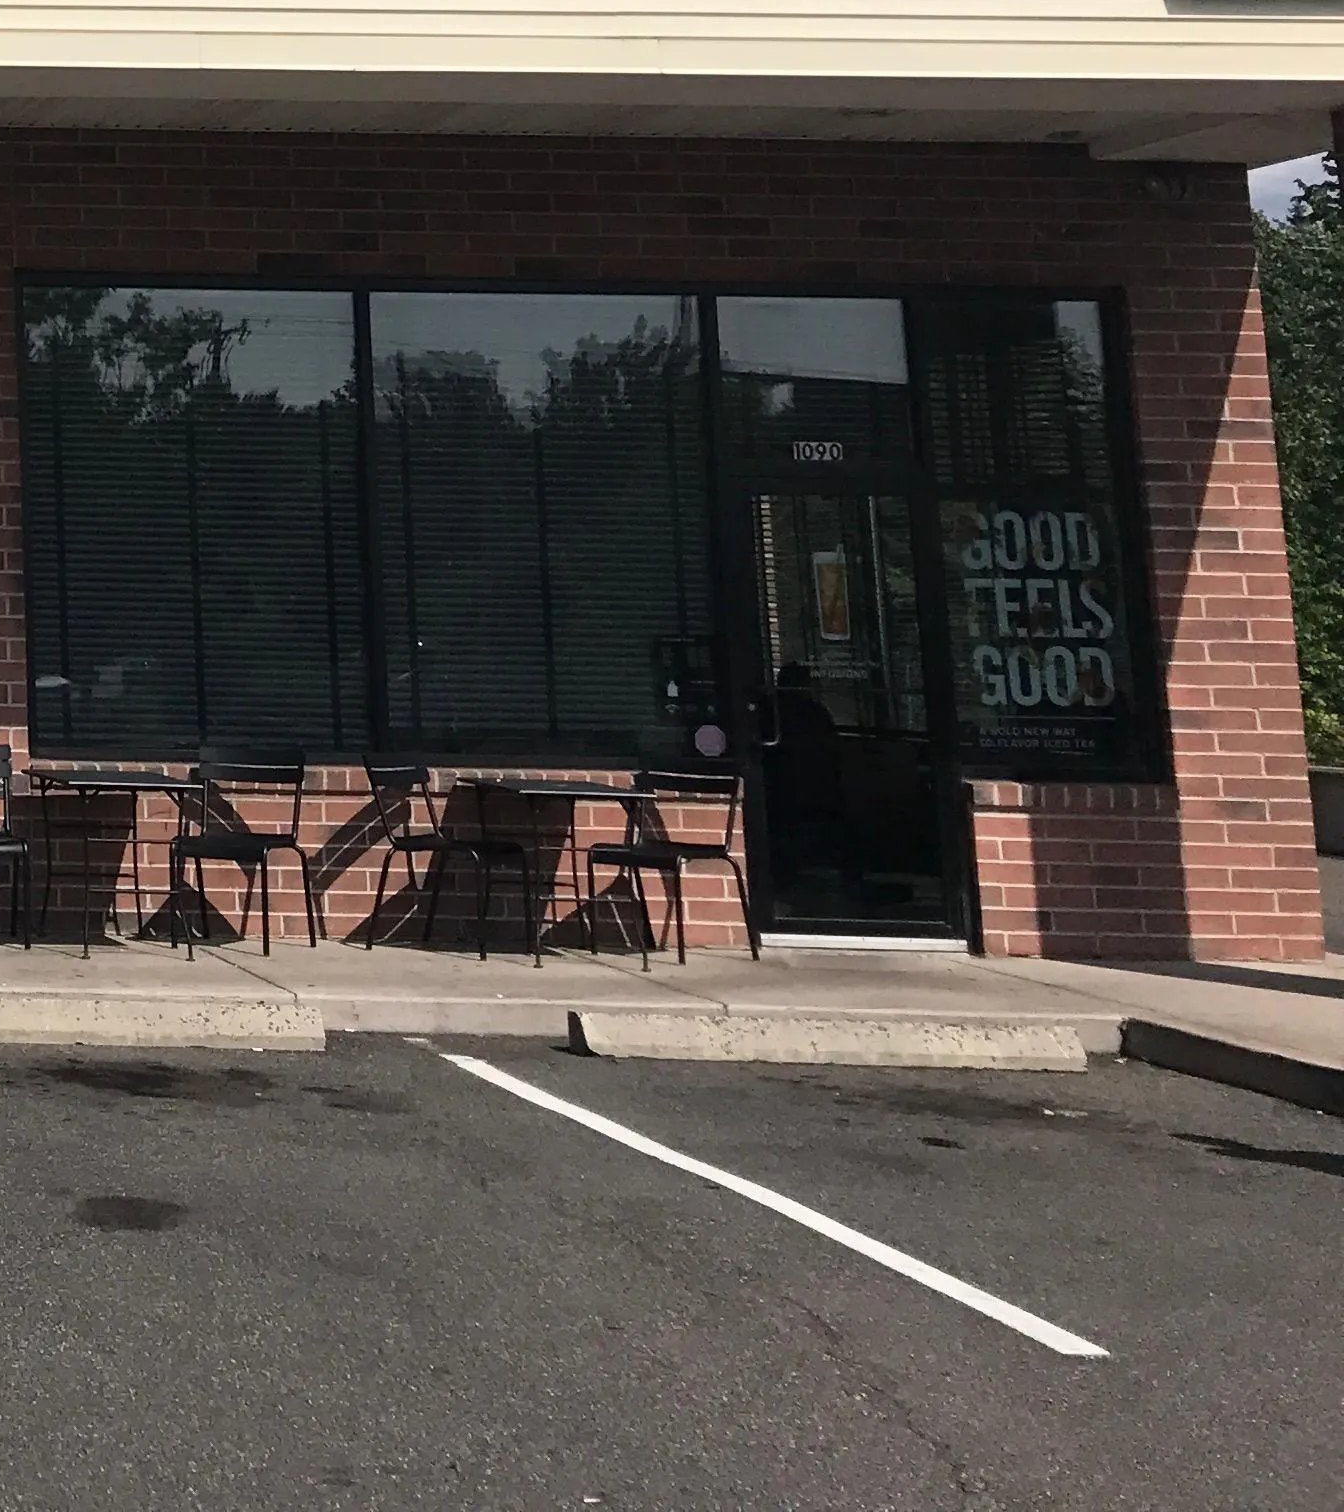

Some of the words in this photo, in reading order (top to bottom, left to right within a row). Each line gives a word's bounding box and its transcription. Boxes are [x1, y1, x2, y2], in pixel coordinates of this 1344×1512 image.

[792, 441, 843, 461] 1090
[961, 509, 1101, 572] GOOD
[963, 577, 1115, 639] FEELS
[972, 643, 1116, 708] GOOD
[1023, 727, 1050, 736] NEW
[1043, 739, 1071, 749] ICED
[1074, 739, 1096, 749] TEA
